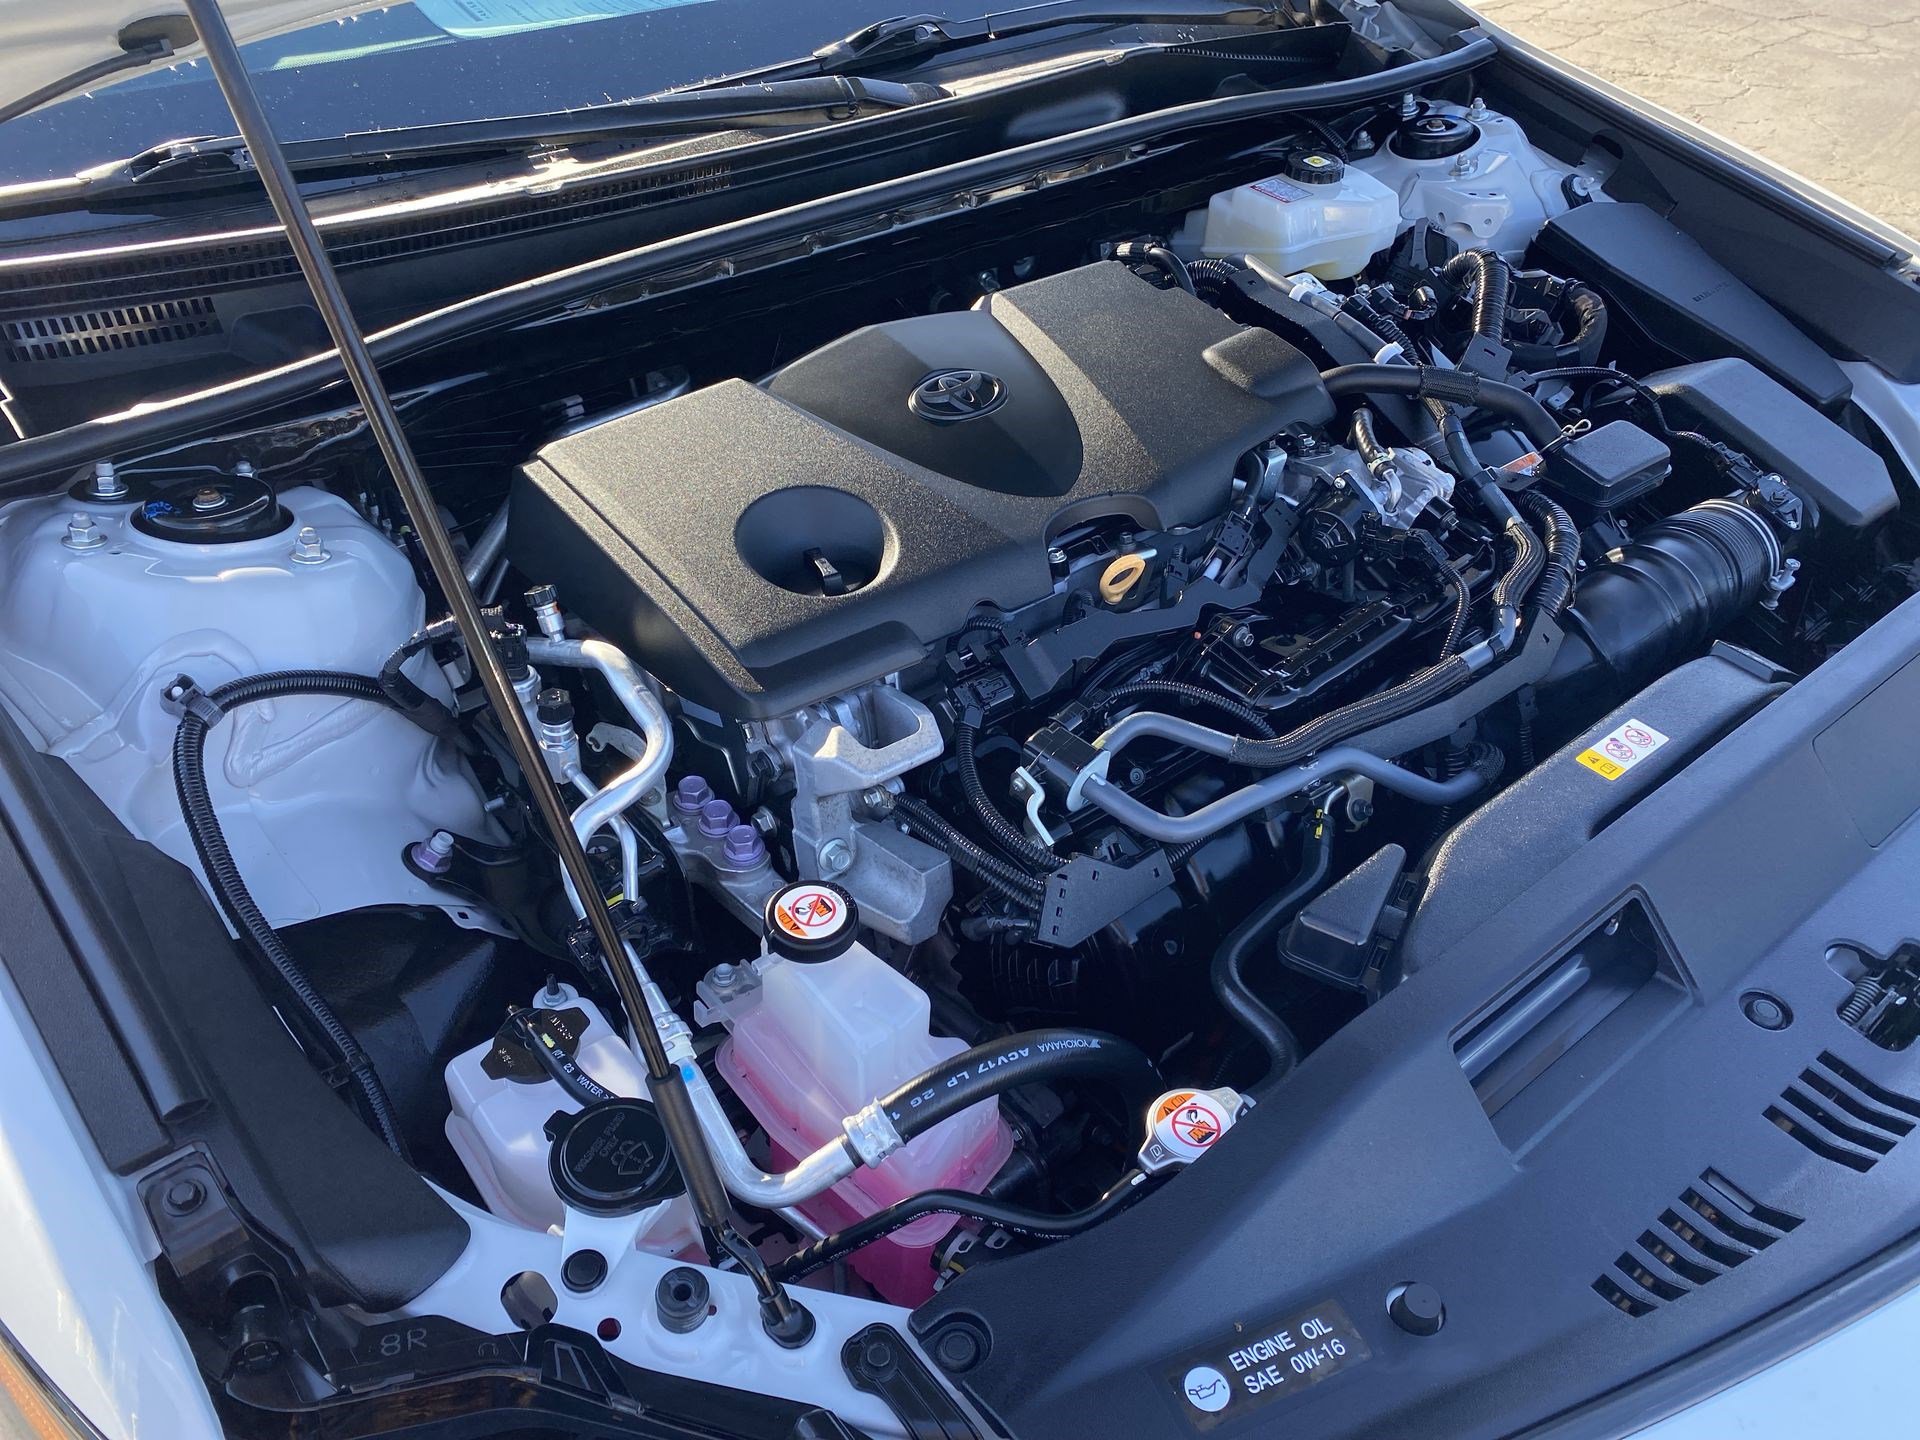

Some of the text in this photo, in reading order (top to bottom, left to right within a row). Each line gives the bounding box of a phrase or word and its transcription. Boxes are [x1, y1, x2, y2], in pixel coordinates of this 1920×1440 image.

[1037, 1038, 1089, 1052] YOKOHAMA
[978, 1047, 1030, 1074] ACV17
[576, 1074, 604, 1098] WATER
[947, 1071, 970, 1088] LP
[1228, 1318, 1333, 1372] ENGINE OIL
[1243, 1339, 1346, 1394] SAE 0W-16
